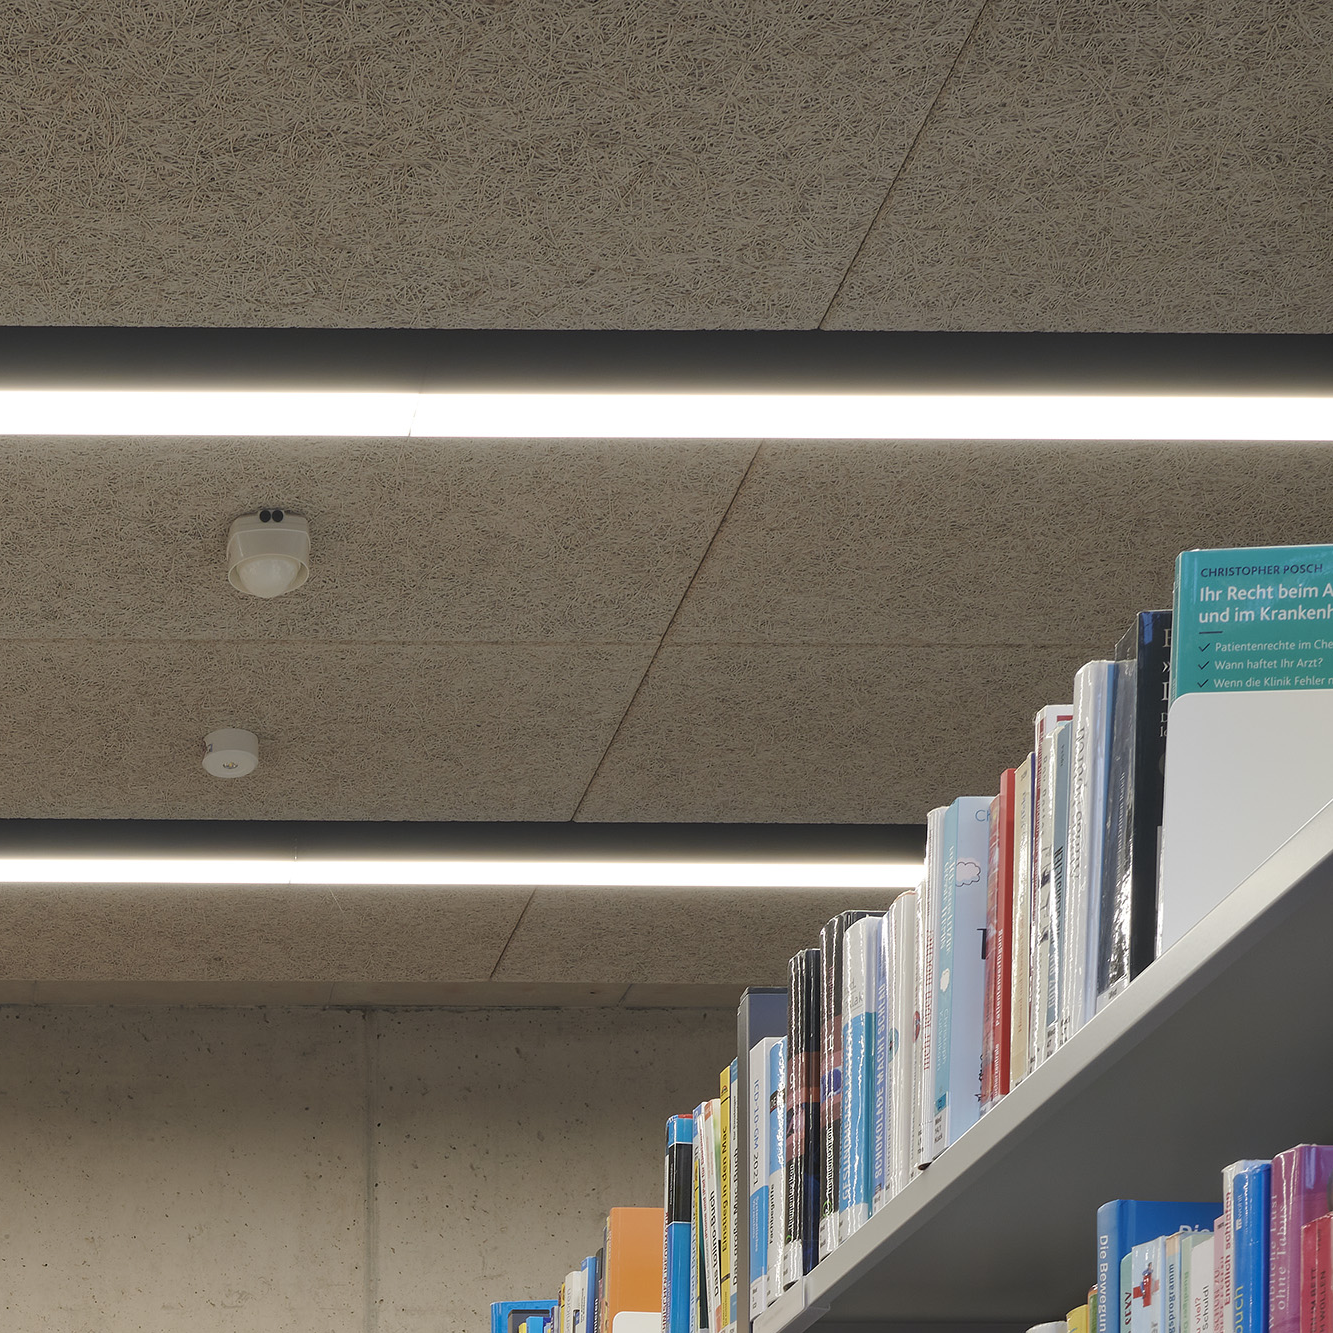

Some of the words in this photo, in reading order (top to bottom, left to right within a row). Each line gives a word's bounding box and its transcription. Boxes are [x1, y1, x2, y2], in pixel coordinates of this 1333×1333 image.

[1201, 566, 1280, 577] CHRISTOPHER
[1283, 564, 1323, 574] POSCH
[1200, 586, 1222, 602] Ihr
[1227, 585, 1273, 601] Recht
[1279, 584, 1318, 599] beim
[1199, 607, 1229, 623] und
[1234, 606, 1255, 622] im
[1215, 640, 1296, 652] Patientenrechte
[1298, 640, 1311, 650] im
[1215, 661, 1244, 670] Wann
[1247, 659, 1277, 668] haftet
[1281, 658, 1294, 667] Ihr
[1297, 658, 1323, 667] Arzt?
[1214, 679, 1243, 688] Wenn
[1246, 677, 1261, 686] die
[1264, 677, 1291, 686] Klinik
[1293, 676, 1324, 685] Fehler
